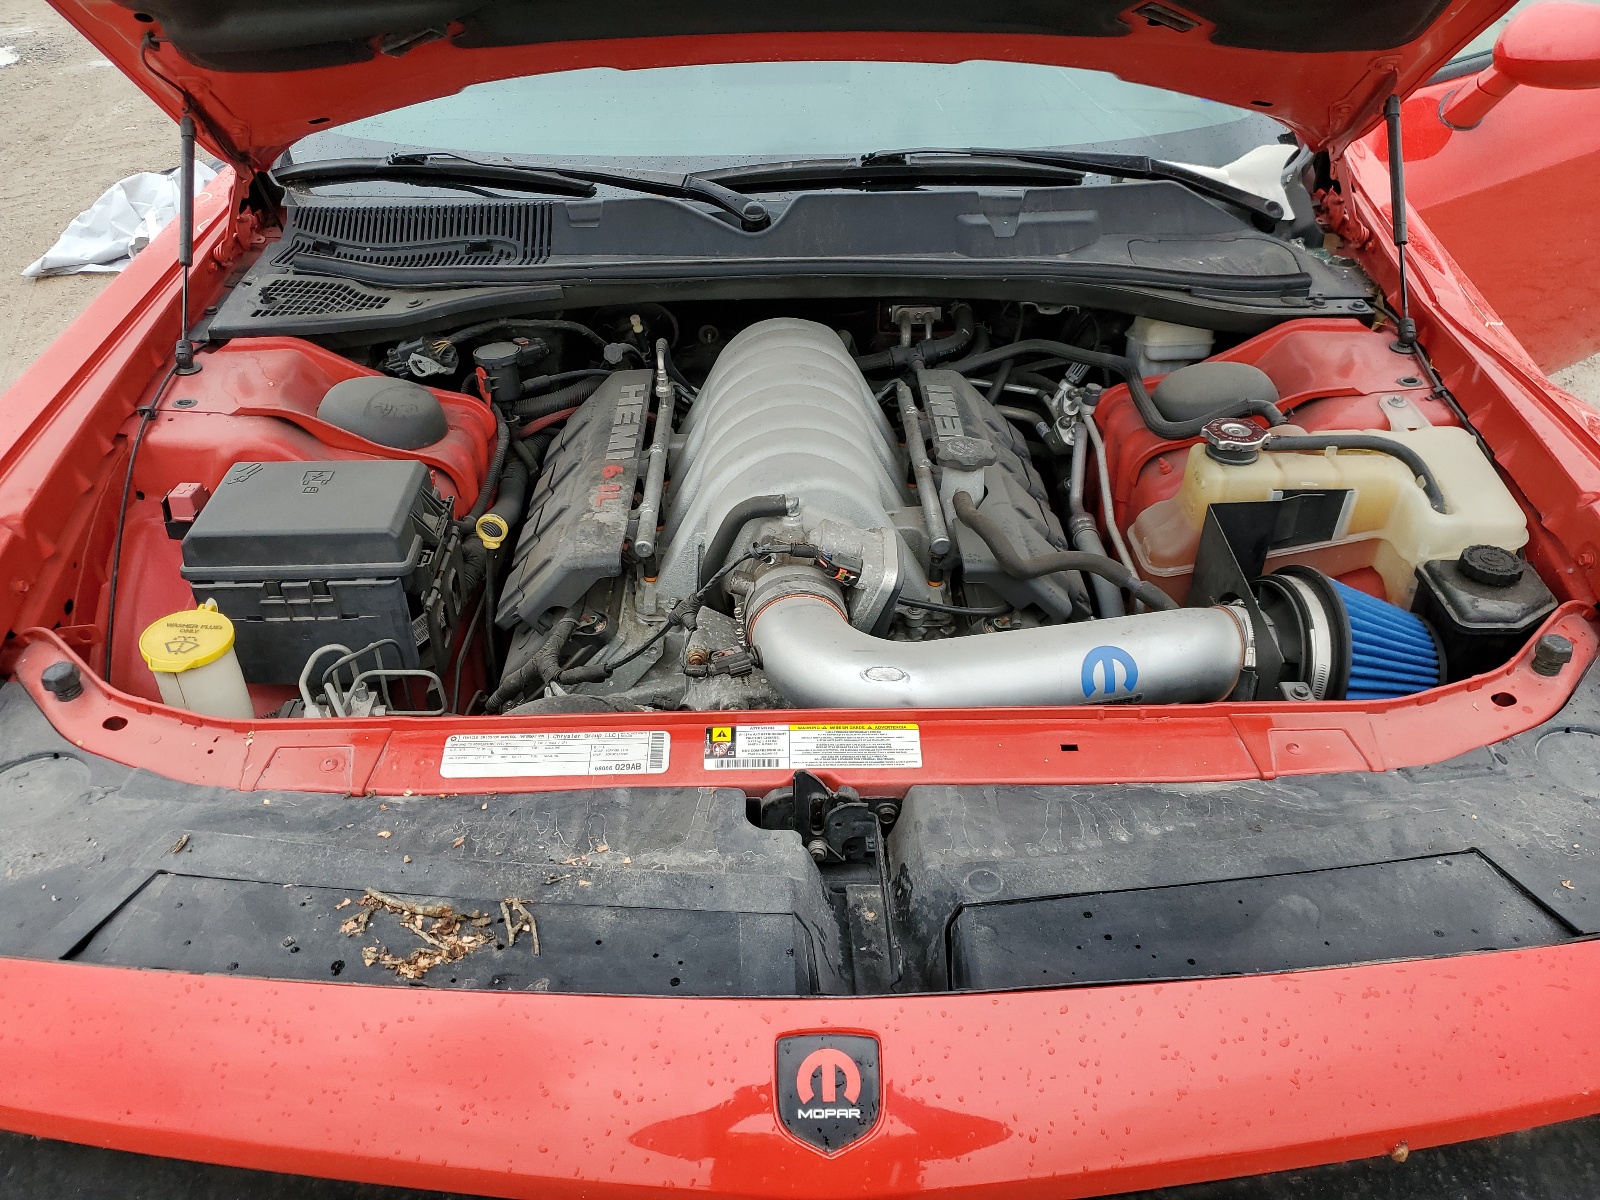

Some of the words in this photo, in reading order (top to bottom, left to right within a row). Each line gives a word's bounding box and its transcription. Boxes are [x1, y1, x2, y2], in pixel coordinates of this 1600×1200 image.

[606, 384, 646, 461] HEMI
[926, 384, 965, 441] EMI
[614, 762, 642, 771] 029AB
[797, 1108, 861, 1119] MOPAR
